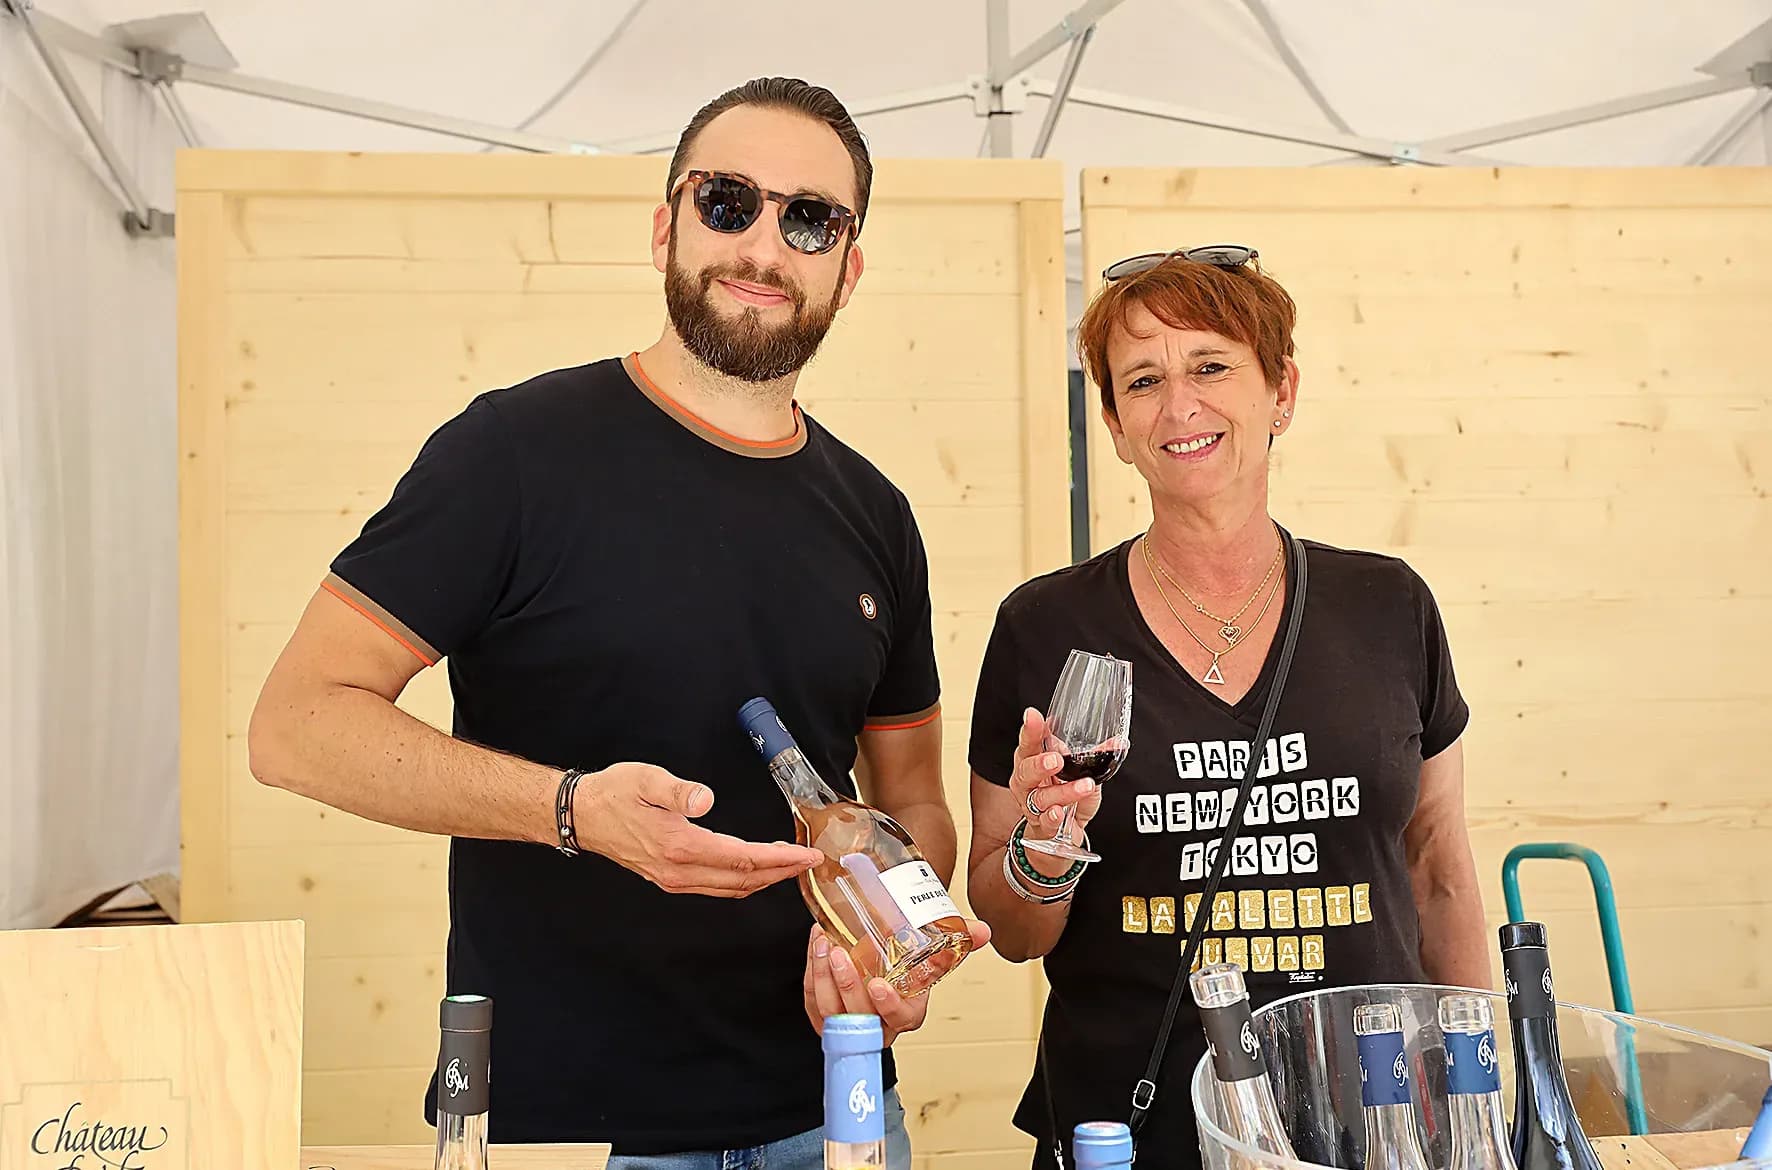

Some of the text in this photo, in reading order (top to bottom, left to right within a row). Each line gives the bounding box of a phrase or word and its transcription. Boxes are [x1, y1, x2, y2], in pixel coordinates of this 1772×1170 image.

[1179, 740, 1302, 772] PARIS
[1138, 784, 1357, 826] NEW-YORK
[1127, 898, 1175, 928] LA
[31, 1102, 168, 1155] Château
